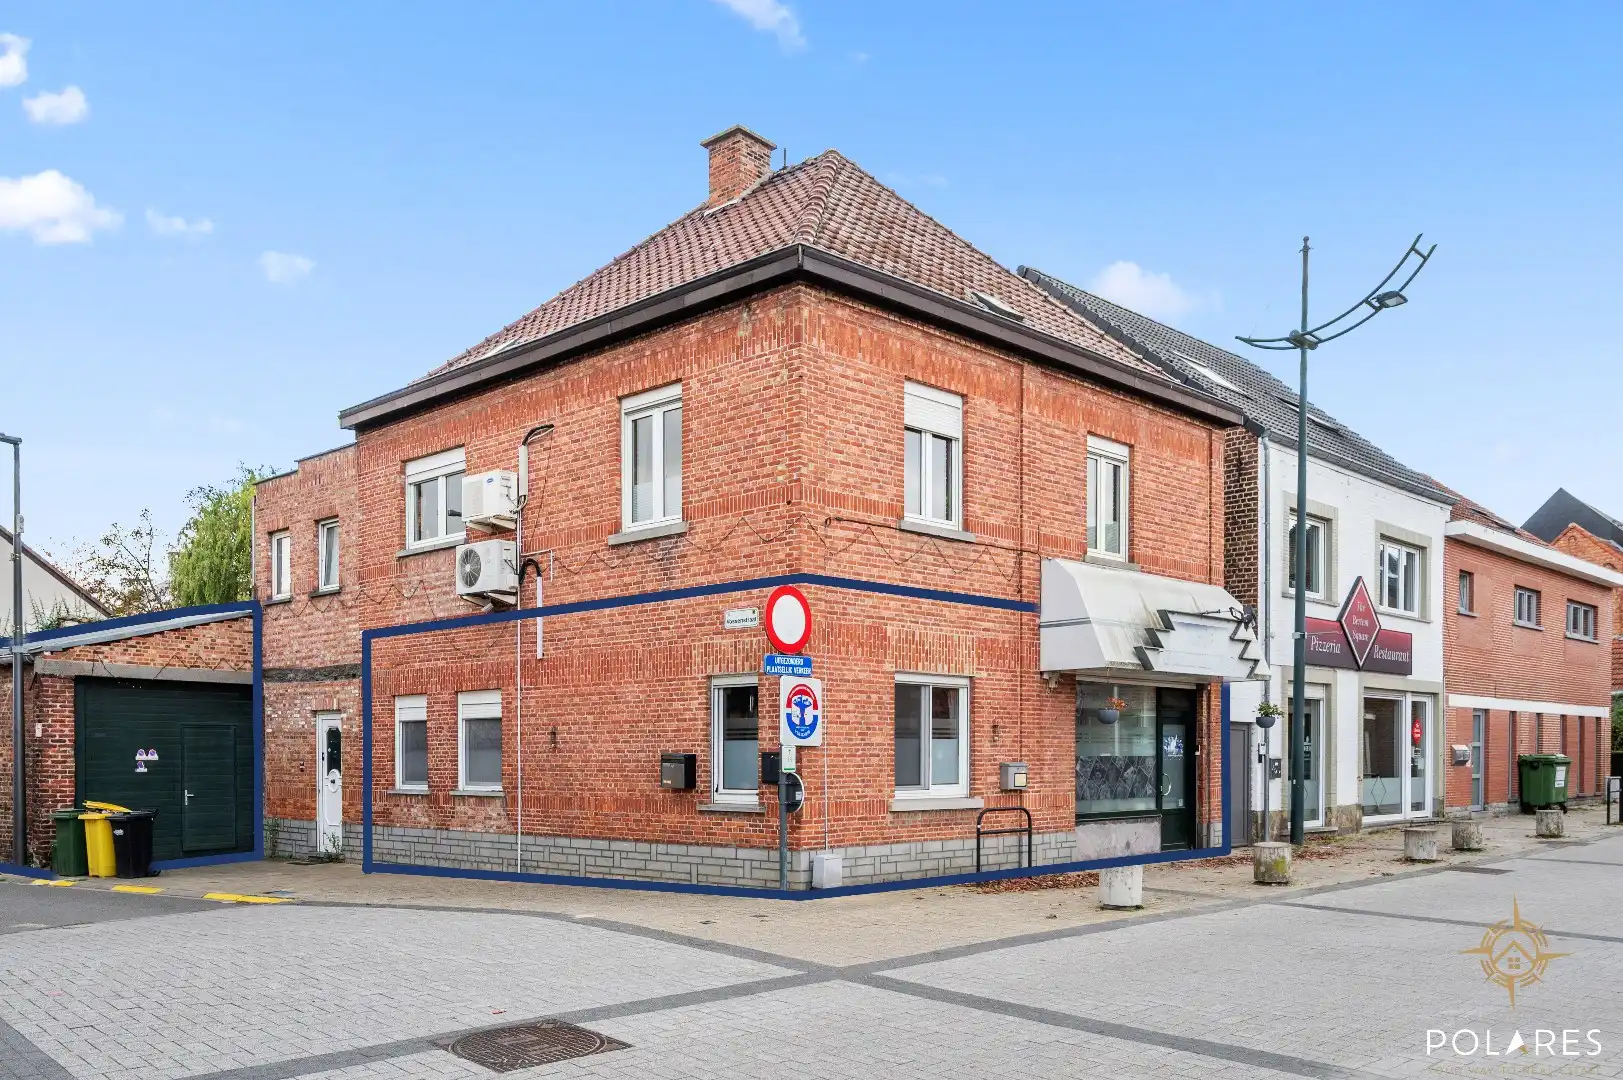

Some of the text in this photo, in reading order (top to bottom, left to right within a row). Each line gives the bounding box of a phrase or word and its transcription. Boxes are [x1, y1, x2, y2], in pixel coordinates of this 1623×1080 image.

[1310, 635, 1341, 654] Pizzeria
[1373, 644, 1410, 663] Restaurant
[793, 666, 812, 675] VERKEER
